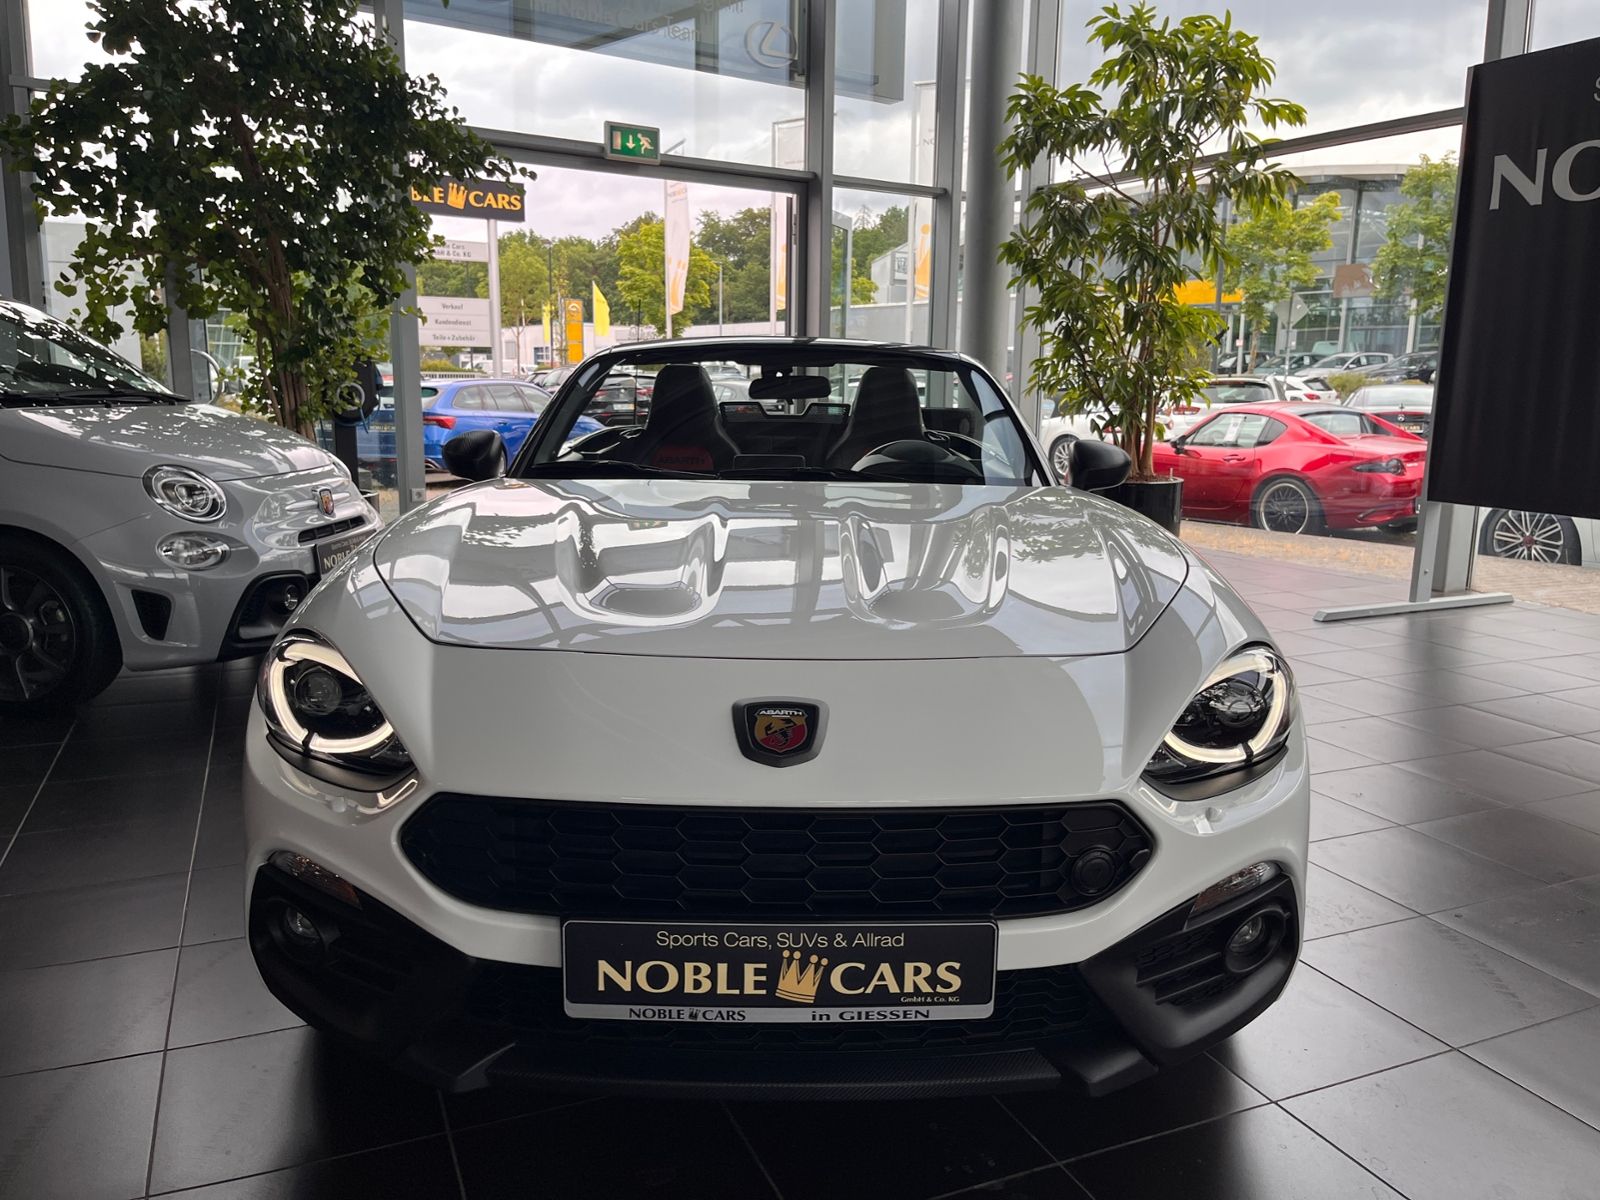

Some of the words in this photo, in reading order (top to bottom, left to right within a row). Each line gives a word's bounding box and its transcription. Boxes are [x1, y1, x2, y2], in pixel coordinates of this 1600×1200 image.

[468, 191, 522, 210] CARS
[656, 931, 719, 949] Sports
[723, 931, 772, 950] Cars,
[777, 931, 828, 948] SUVs
[834, 932, 848, 947] &
[853, 931, 905, 947] Allrad
[598, 960, 767, 994] NOBLE
[829, 962, 962, 994] CARS
[628, 1008, 685, 1021] NOBLE
[702, 1008, 746, 1021] CARS
[811, 1009, 831, 1021] in
[839, 1009, 930, 1021] GIESSEN
